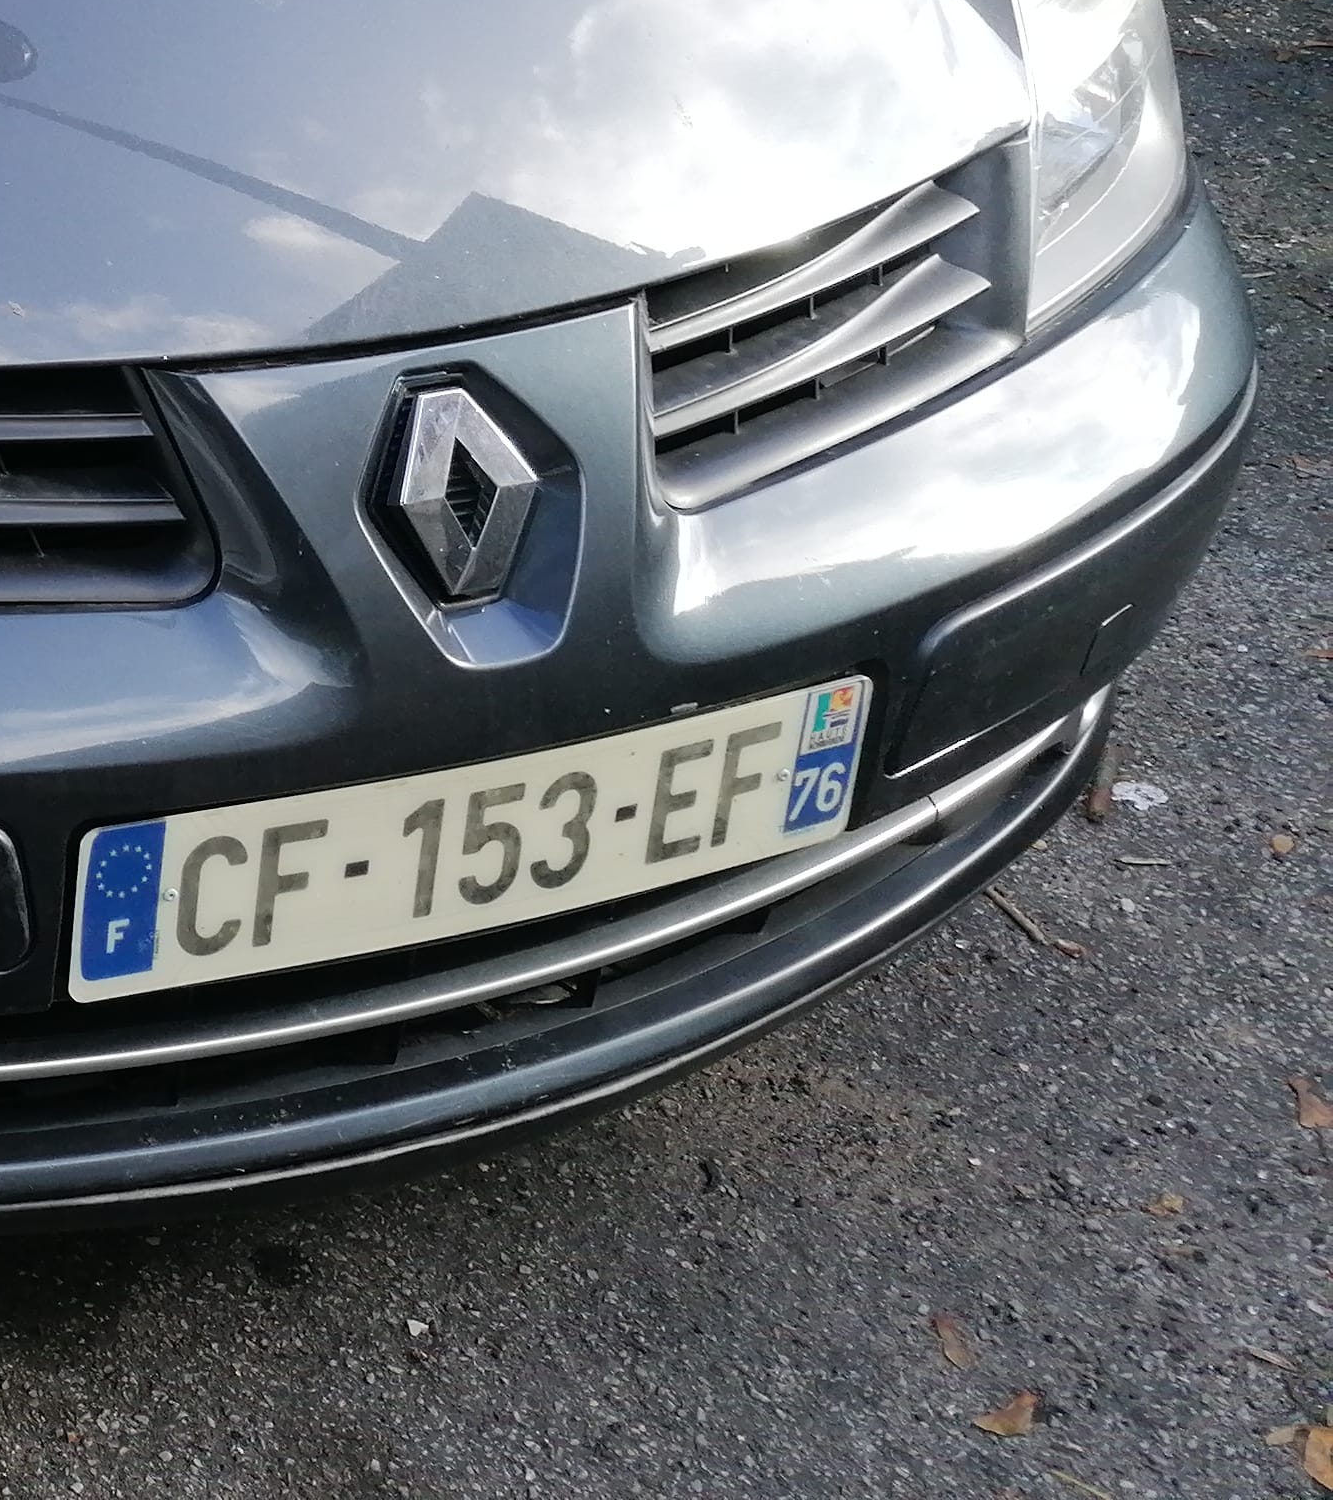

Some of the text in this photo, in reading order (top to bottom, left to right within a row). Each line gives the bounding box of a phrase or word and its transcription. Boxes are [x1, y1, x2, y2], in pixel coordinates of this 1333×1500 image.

[789, 762, 846, 823] 76
[176, 721, 783, 957] CF-153-EF
[106, 918, 130, 954] F
